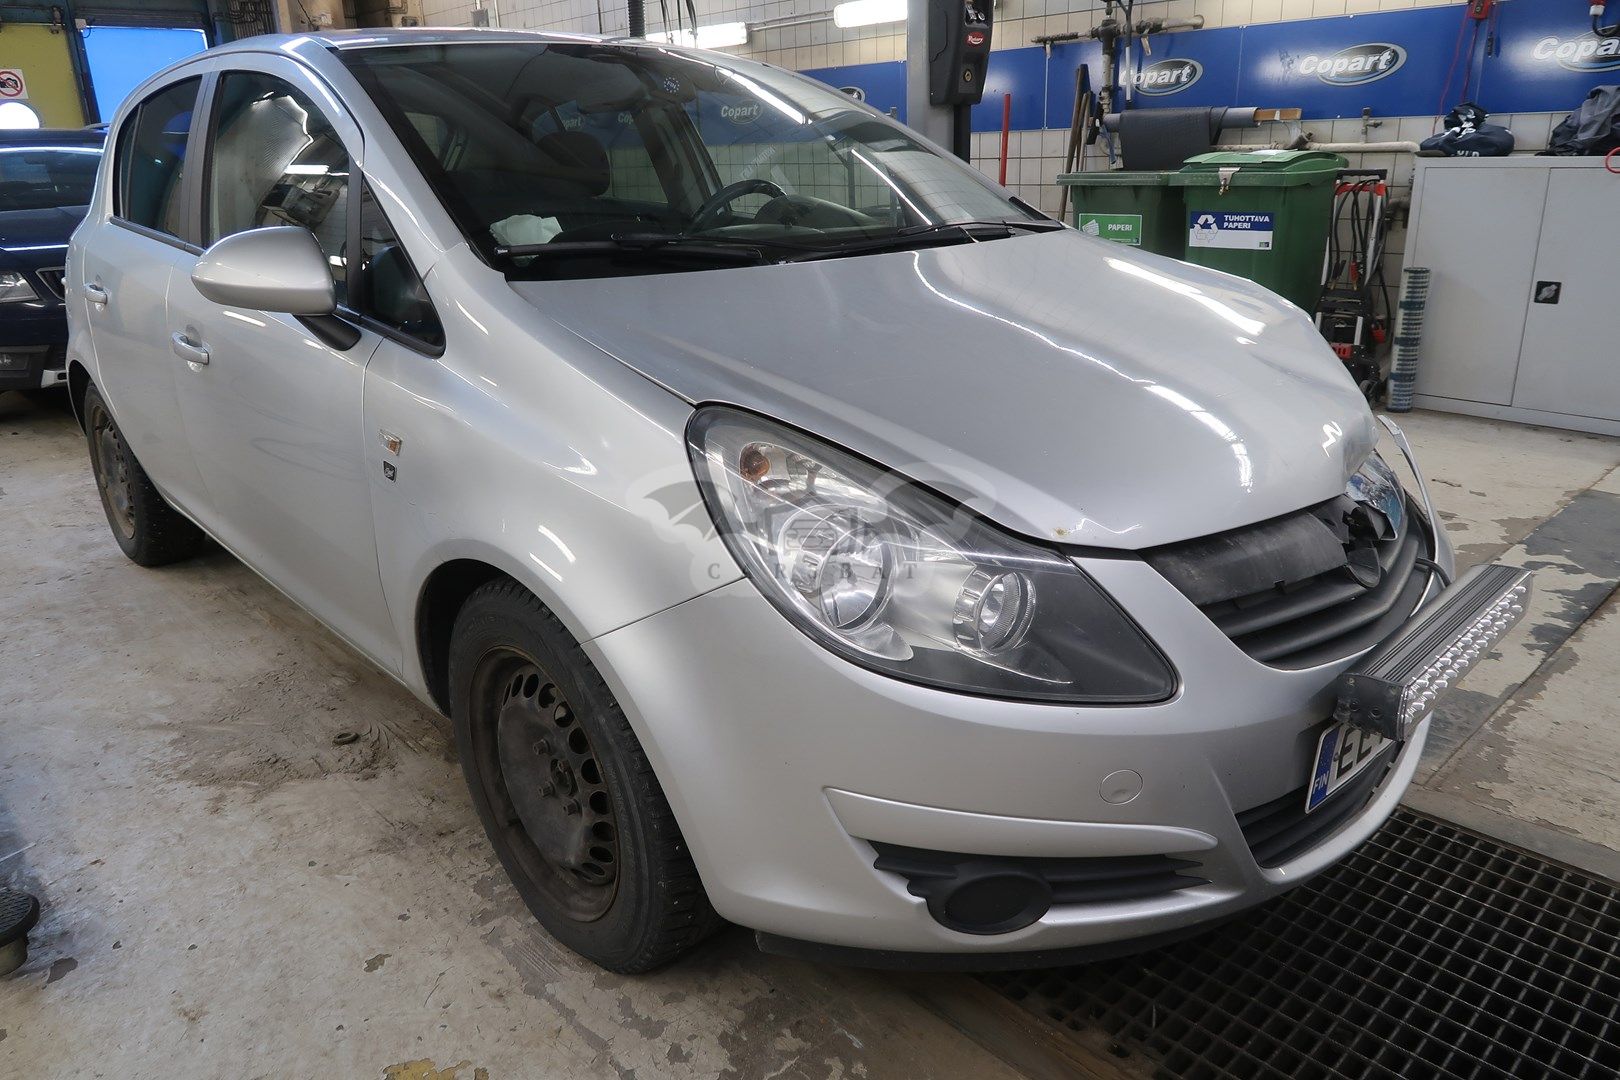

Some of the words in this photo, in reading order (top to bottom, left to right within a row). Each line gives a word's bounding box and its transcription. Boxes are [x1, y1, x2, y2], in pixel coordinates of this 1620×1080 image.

[1533, 36, 1620, 63] Copa
[1300, 50, 1394, 78] Copart
[1119, 65, 1191, 88] Copart
[721, 104, 760, 120] Copart
[1107, 223, 1133, 232] PAPERI
[1223, 214, 1270, 223] TUHOTTAVA
[1335, 726, 1384, 780] EE
[1312, 770, 1330, 795] FIN
